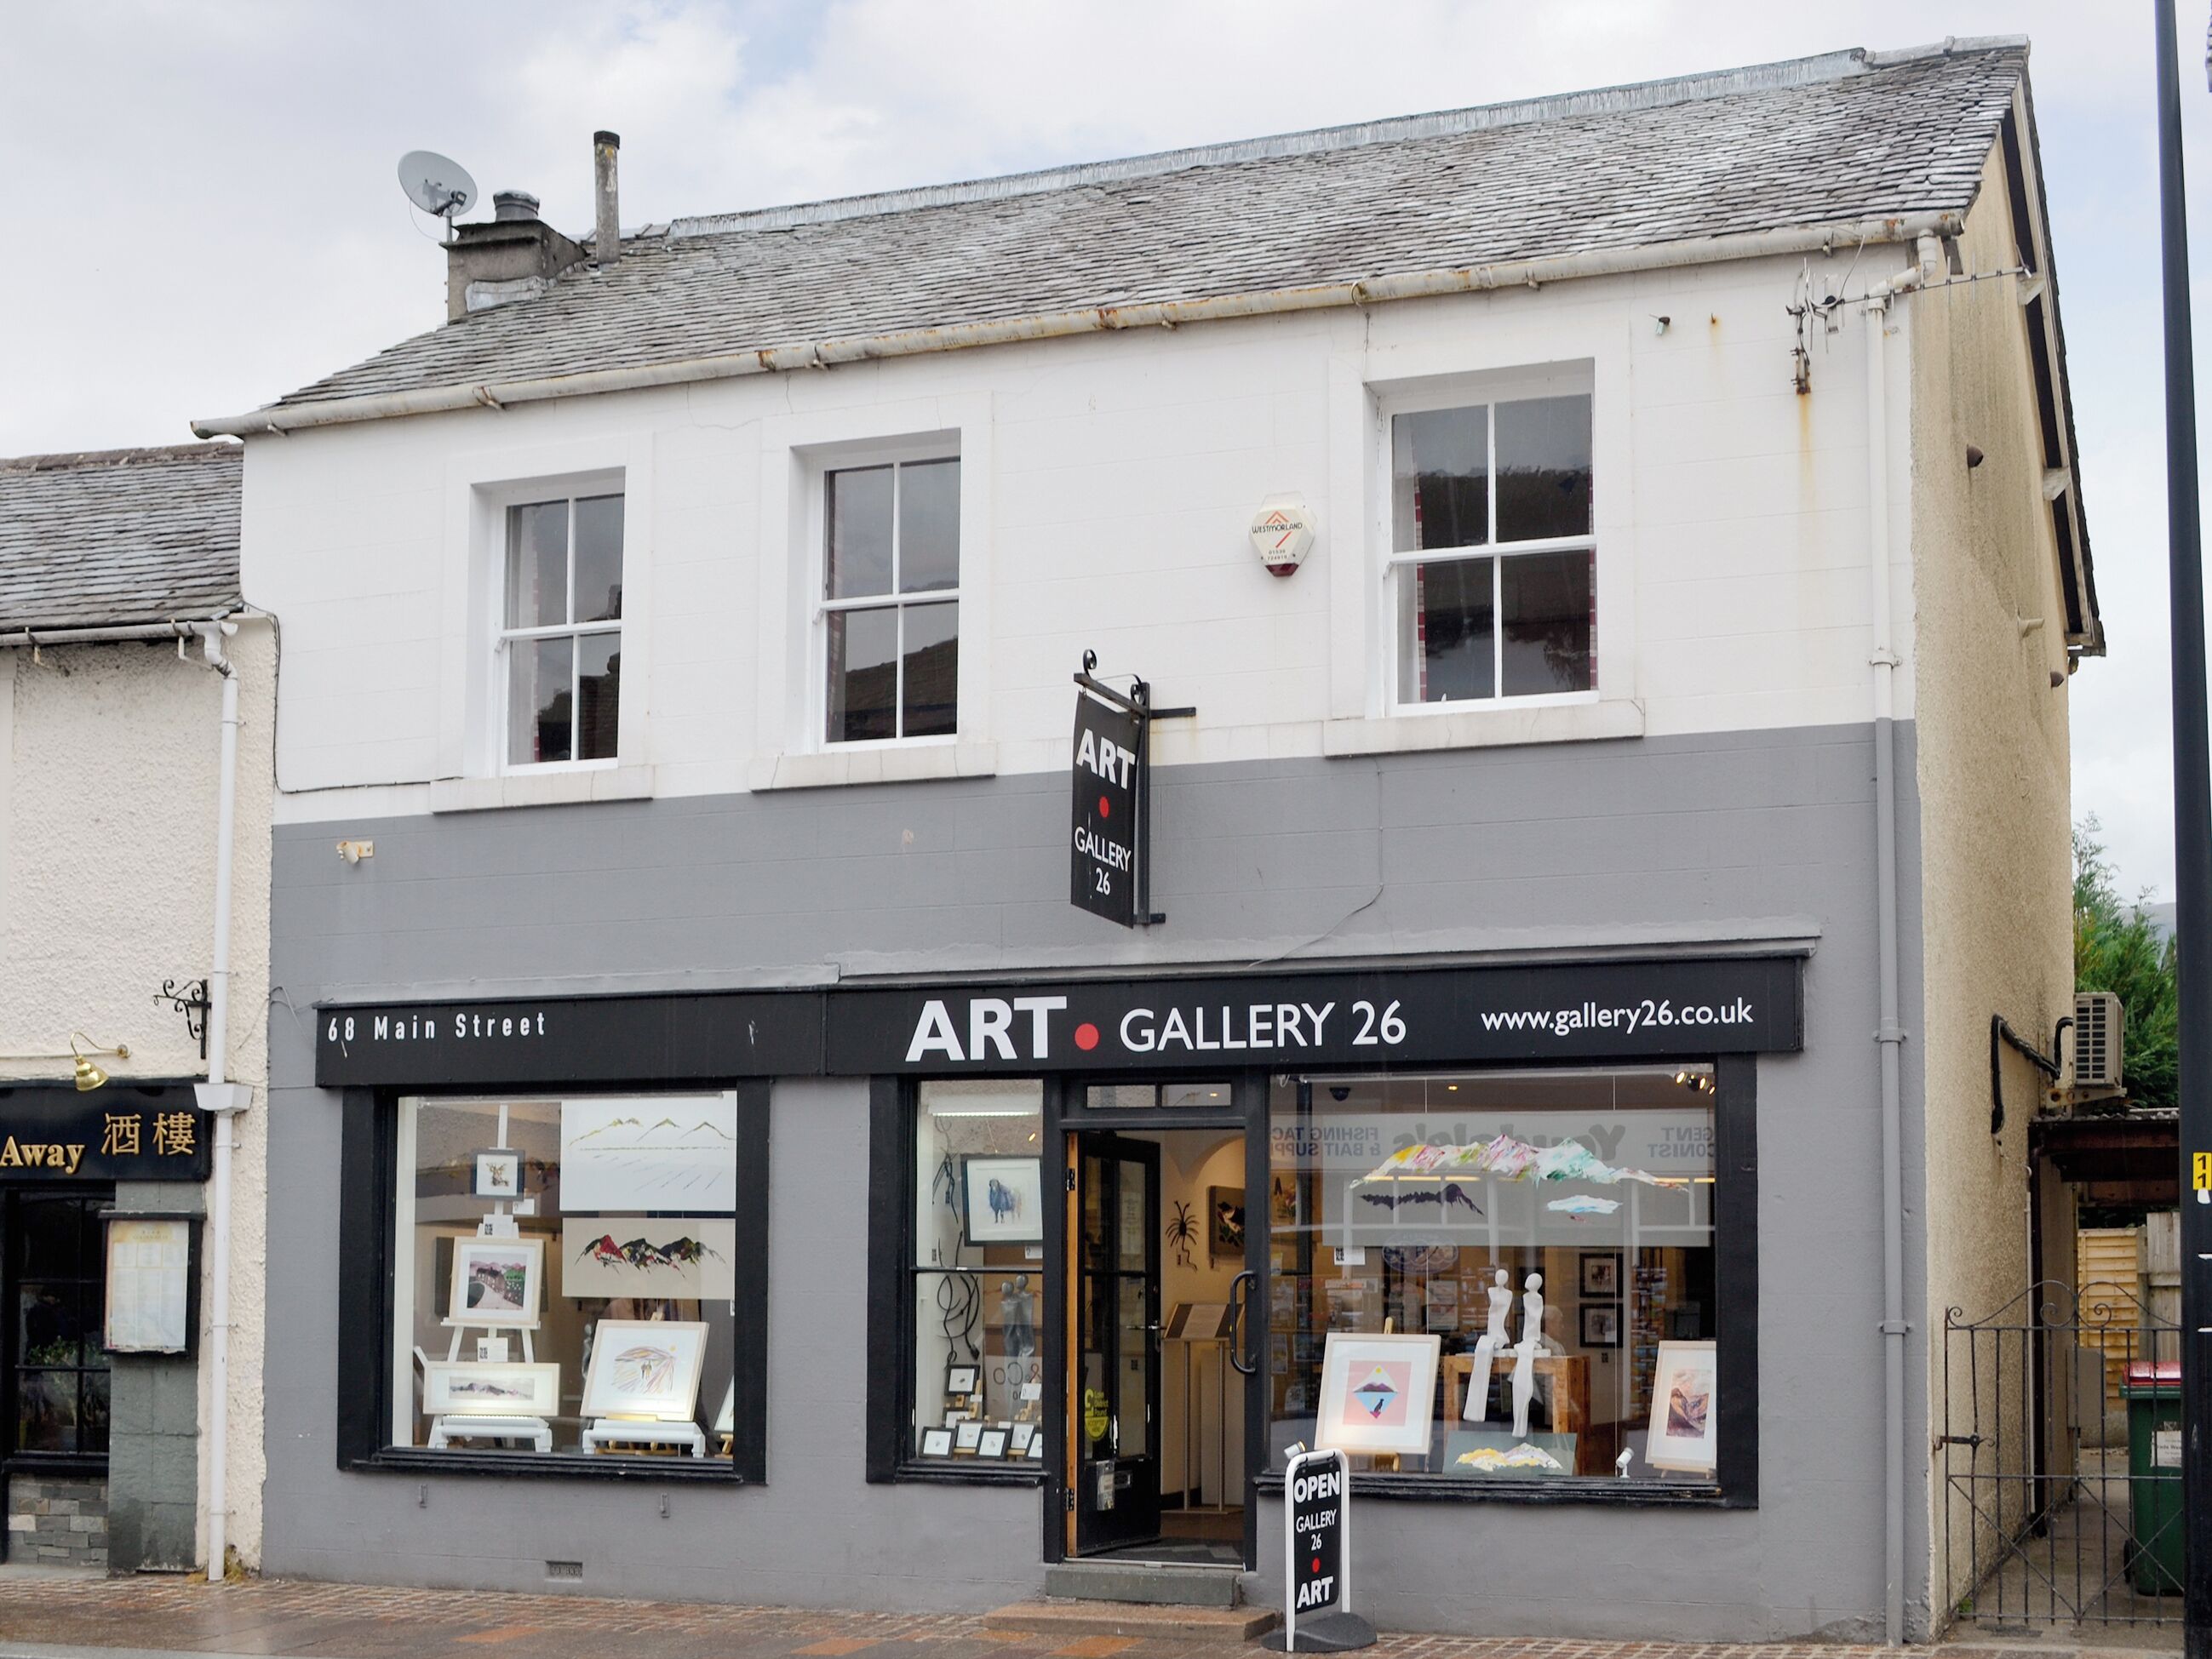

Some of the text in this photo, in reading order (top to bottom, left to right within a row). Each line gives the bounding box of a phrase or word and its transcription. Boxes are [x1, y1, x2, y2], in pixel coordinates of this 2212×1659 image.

[1252, 522, 1303, 535] WESTMORLAND
[1075, 728, 1136, 790] ART
[1074, 827, 1132, 872] GALLERY
[1095, 867, 1111, 895] 26
[328, 1011, 545, 1042] 68 Main Street
[904, 995, 1407, 1062] ART GALLERY 26
[1481, 997, 1754, 1036] www.gallery26.co.uk
[100, 1112, 196, 1155] 酒樓
[0, 1136, 84, 1174] Away
[1293, 1471, 1341, 1503] OPEN
[1296, 1508, 1337, 1534] GALLERY
[1310, 1533, 1322, 1551] 26
[1297, 1576, 1334, 1610] ART
